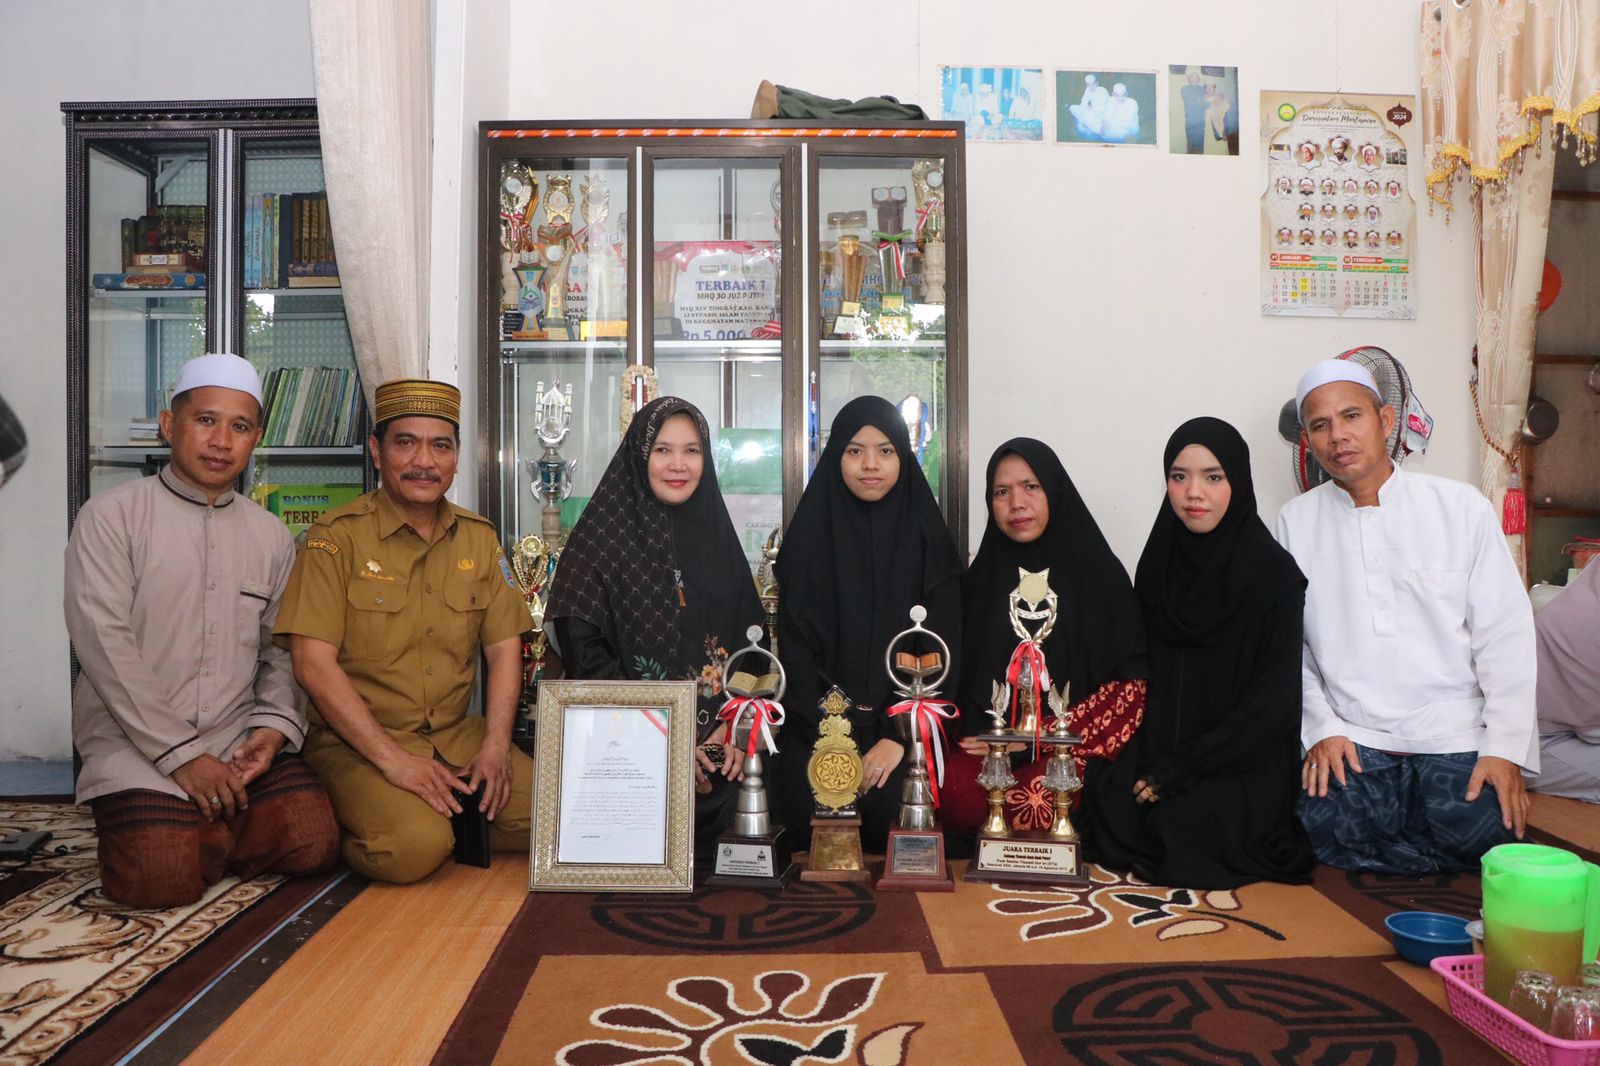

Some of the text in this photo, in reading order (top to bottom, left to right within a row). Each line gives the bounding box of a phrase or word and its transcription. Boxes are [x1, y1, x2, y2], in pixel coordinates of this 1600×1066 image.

[696, 280, 756, 290] TERBAIK
[282, 496, 328, 506] BONUS
[284, 511, 326, 524] TERB
